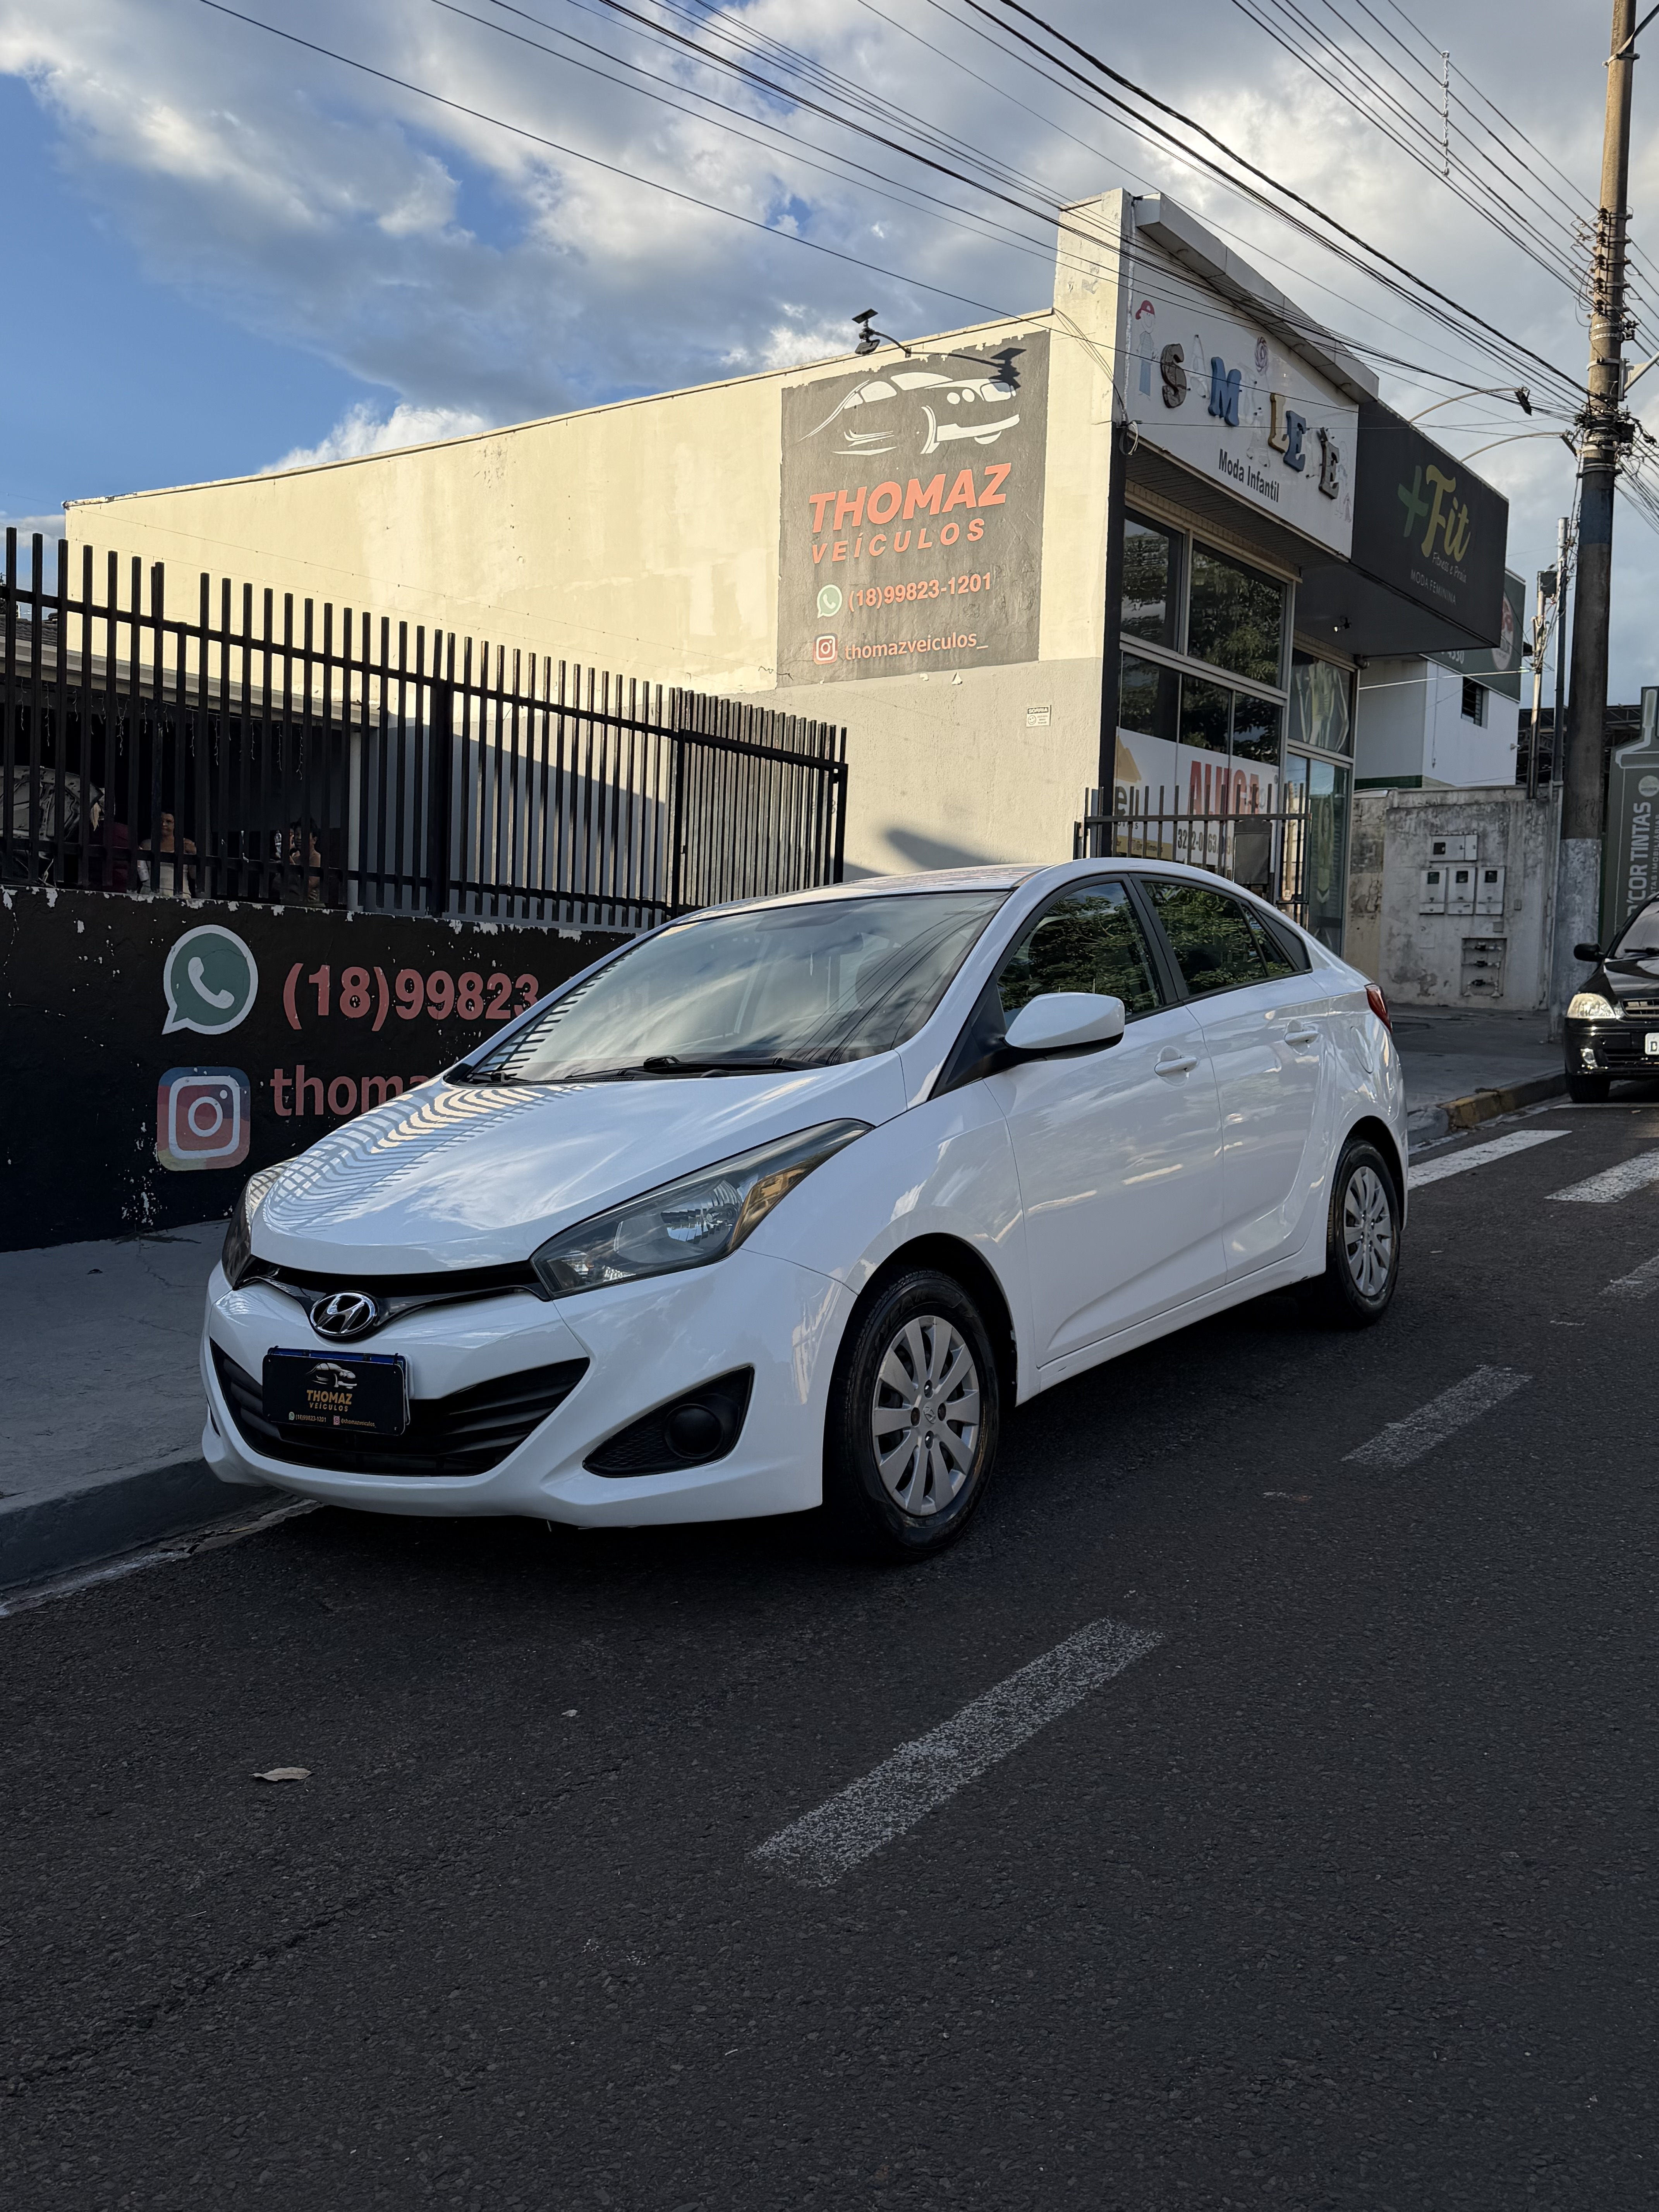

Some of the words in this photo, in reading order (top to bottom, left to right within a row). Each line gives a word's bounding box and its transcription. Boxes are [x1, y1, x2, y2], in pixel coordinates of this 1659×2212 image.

[809, 463, 1012, 533] THOMAZ
[1219, 448, 1245, 483] Moda
[1248, 465, 1280, 503] Infantil
[812, 518, 985, 564] VEÍCULOS
[848, 572, 991, 612] (18)99823-1201
[1410, 569, 1428, 589] MODA
[1429, 580, 1456, 606] FEMININA
[845, 632, 988, 661] thomazveiculos_
[1630, 801, 1651, 862] TINTAS
[283, 962, 539, 1032] (18)99823
[270, 1065, 429, 1116] thom
[306, 1389, 352, 1405] THOMAZ
[309, 1401, 348, 1412] VEÍCULOS
